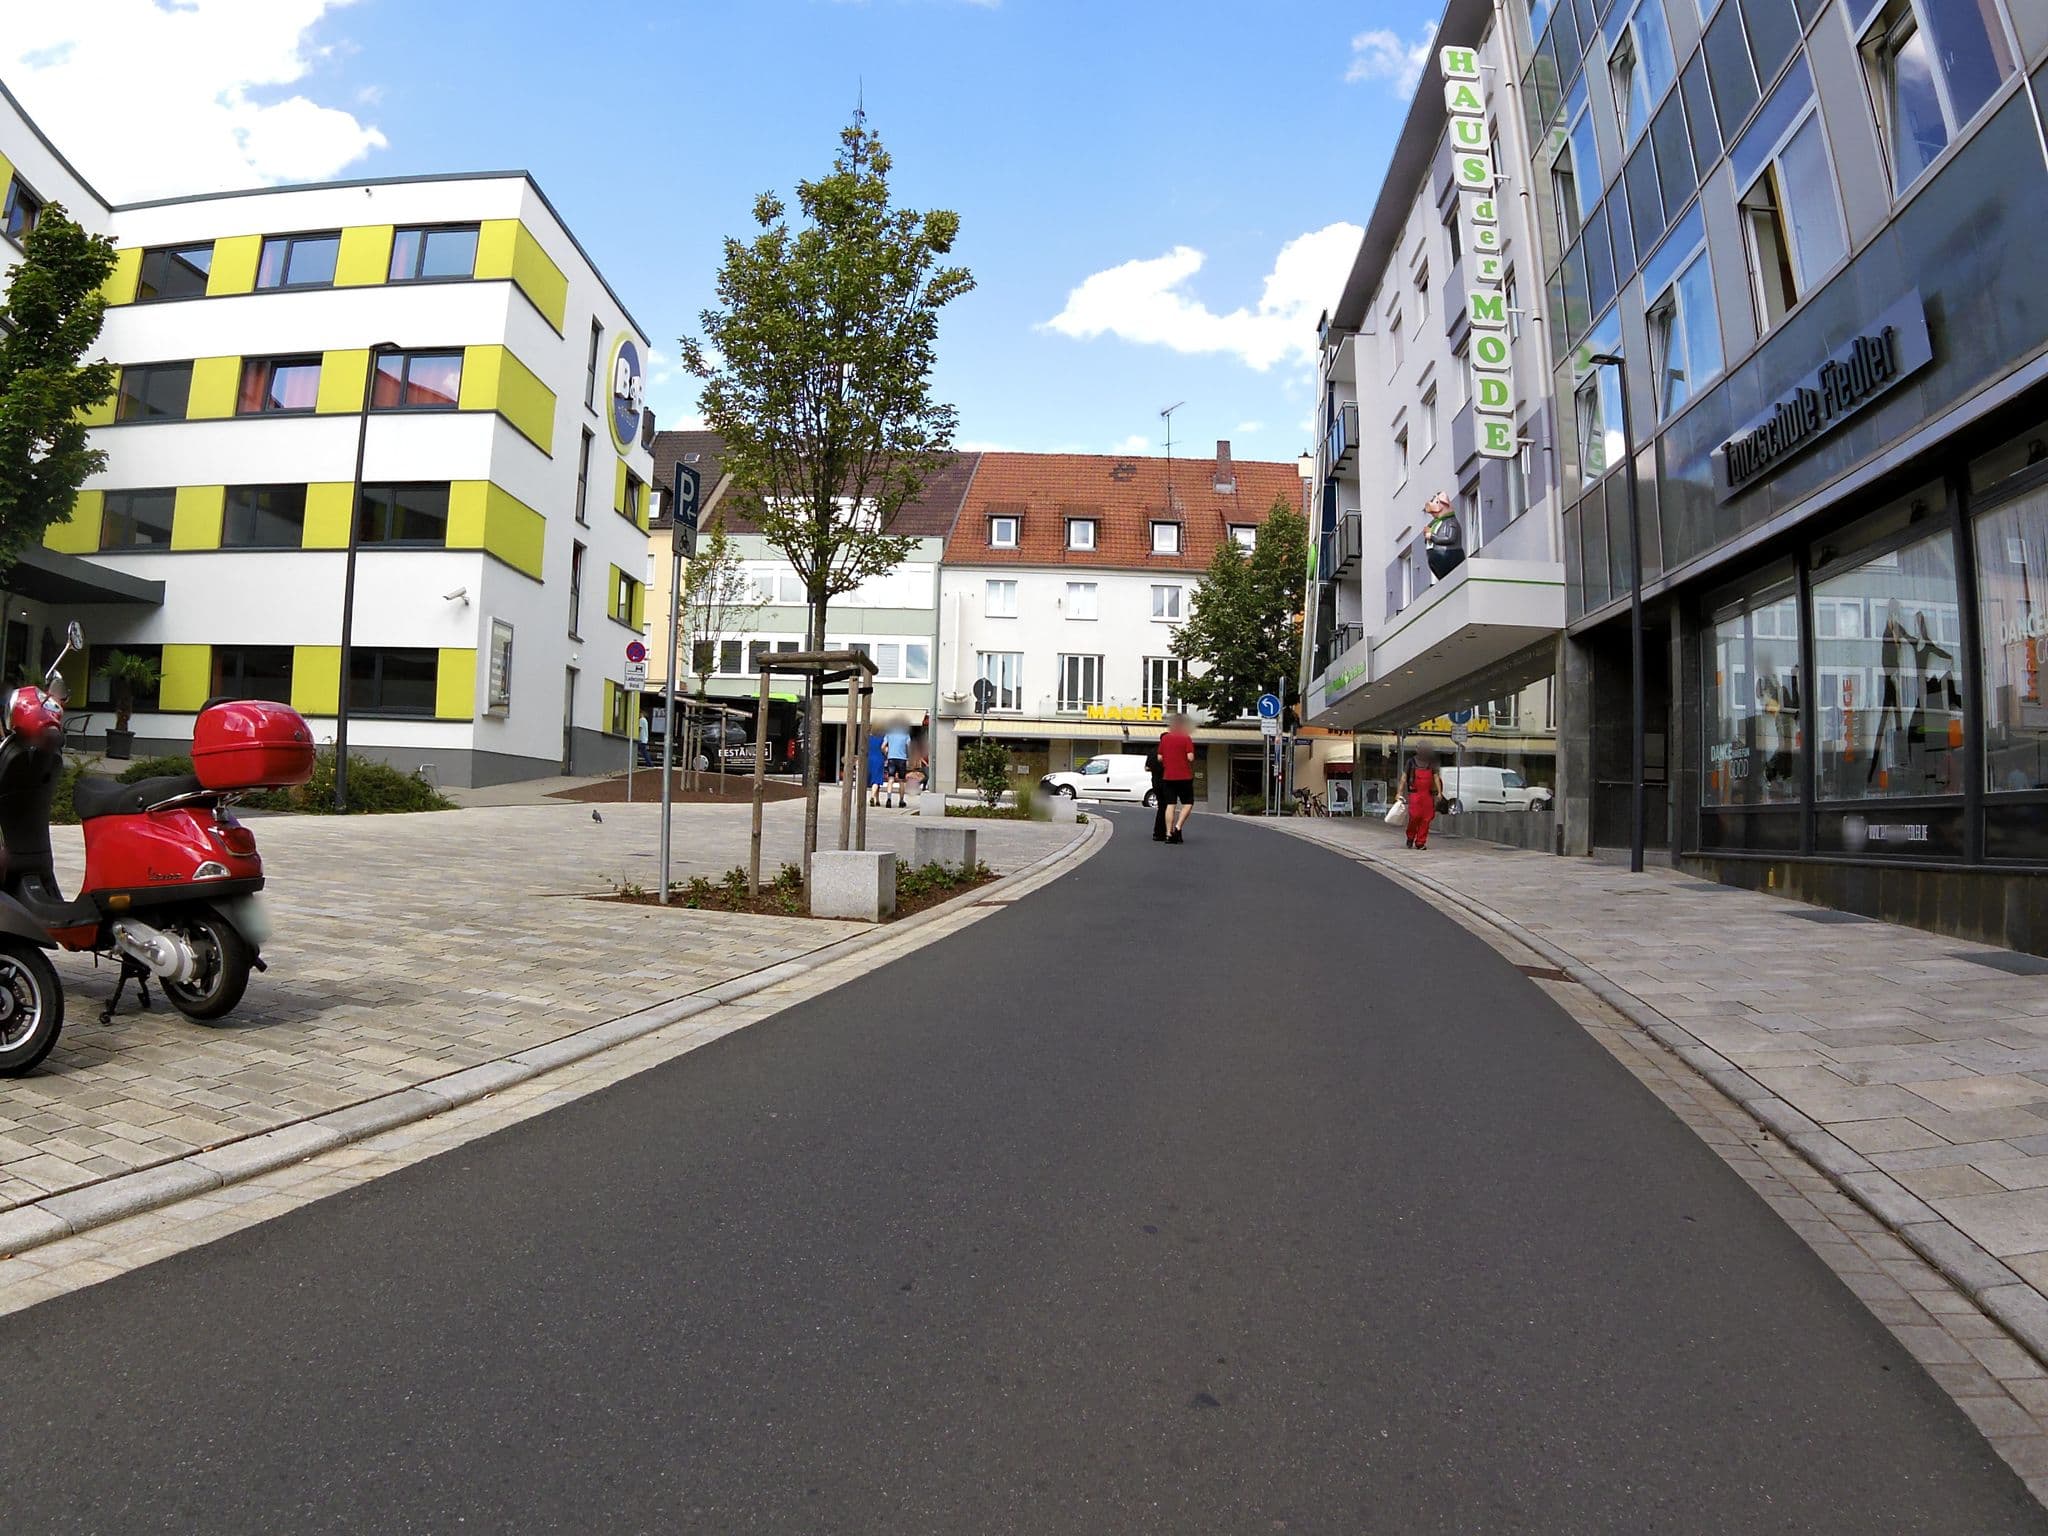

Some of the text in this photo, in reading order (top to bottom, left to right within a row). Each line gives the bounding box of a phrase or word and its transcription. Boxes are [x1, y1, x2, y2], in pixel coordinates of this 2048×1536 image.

[1446, 51, 1511, 452] HAUS der MODE
[1721, 325, 1897, 487] Tanzschule Fiedler
[679, 471, 695, 516] P
